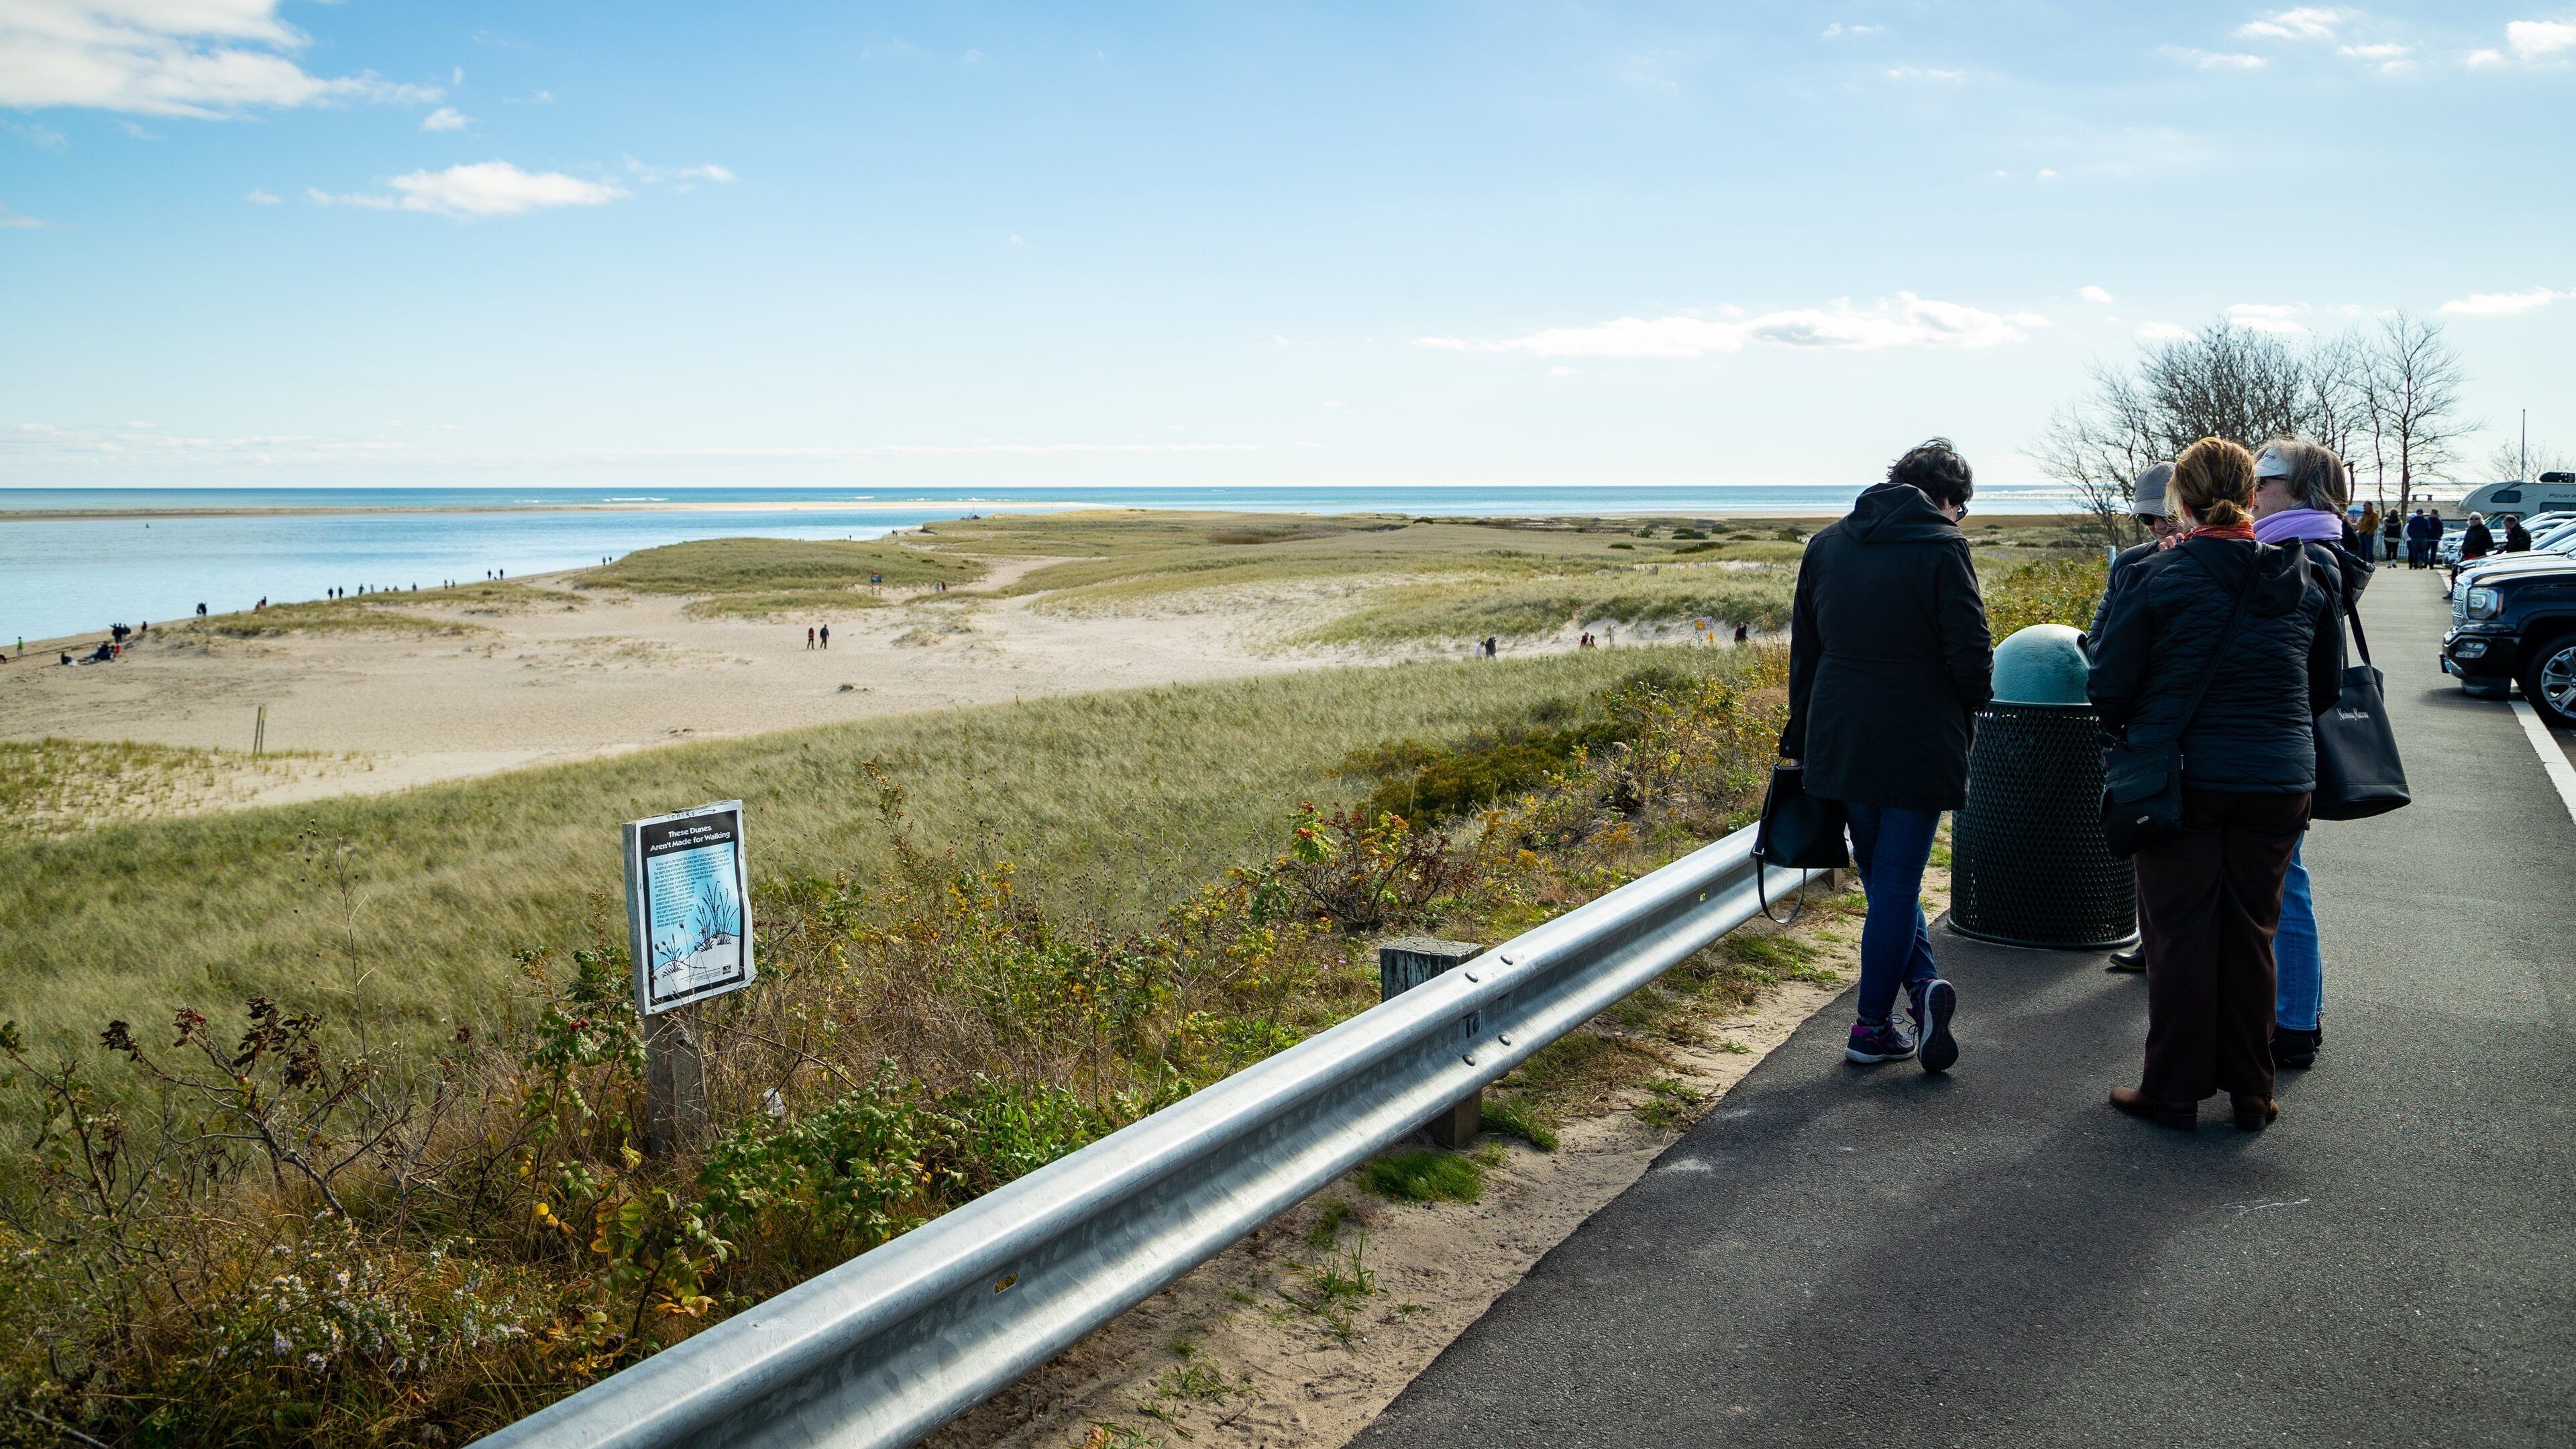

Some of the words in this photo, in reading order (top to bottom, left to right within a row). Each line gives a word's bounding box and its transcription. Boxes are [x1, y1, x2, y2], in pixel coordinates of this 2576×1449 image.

[667, 811, 695, 821] STAIRS
[668, 828, 690, 838] These
[690, 825, 712, 835] Dunes
[650, 841, 671, 852] Aren't
[672, 838, 692, 847] Made
[693, 836, 704, 844] for
[704, 831, 731, 841] Walking
